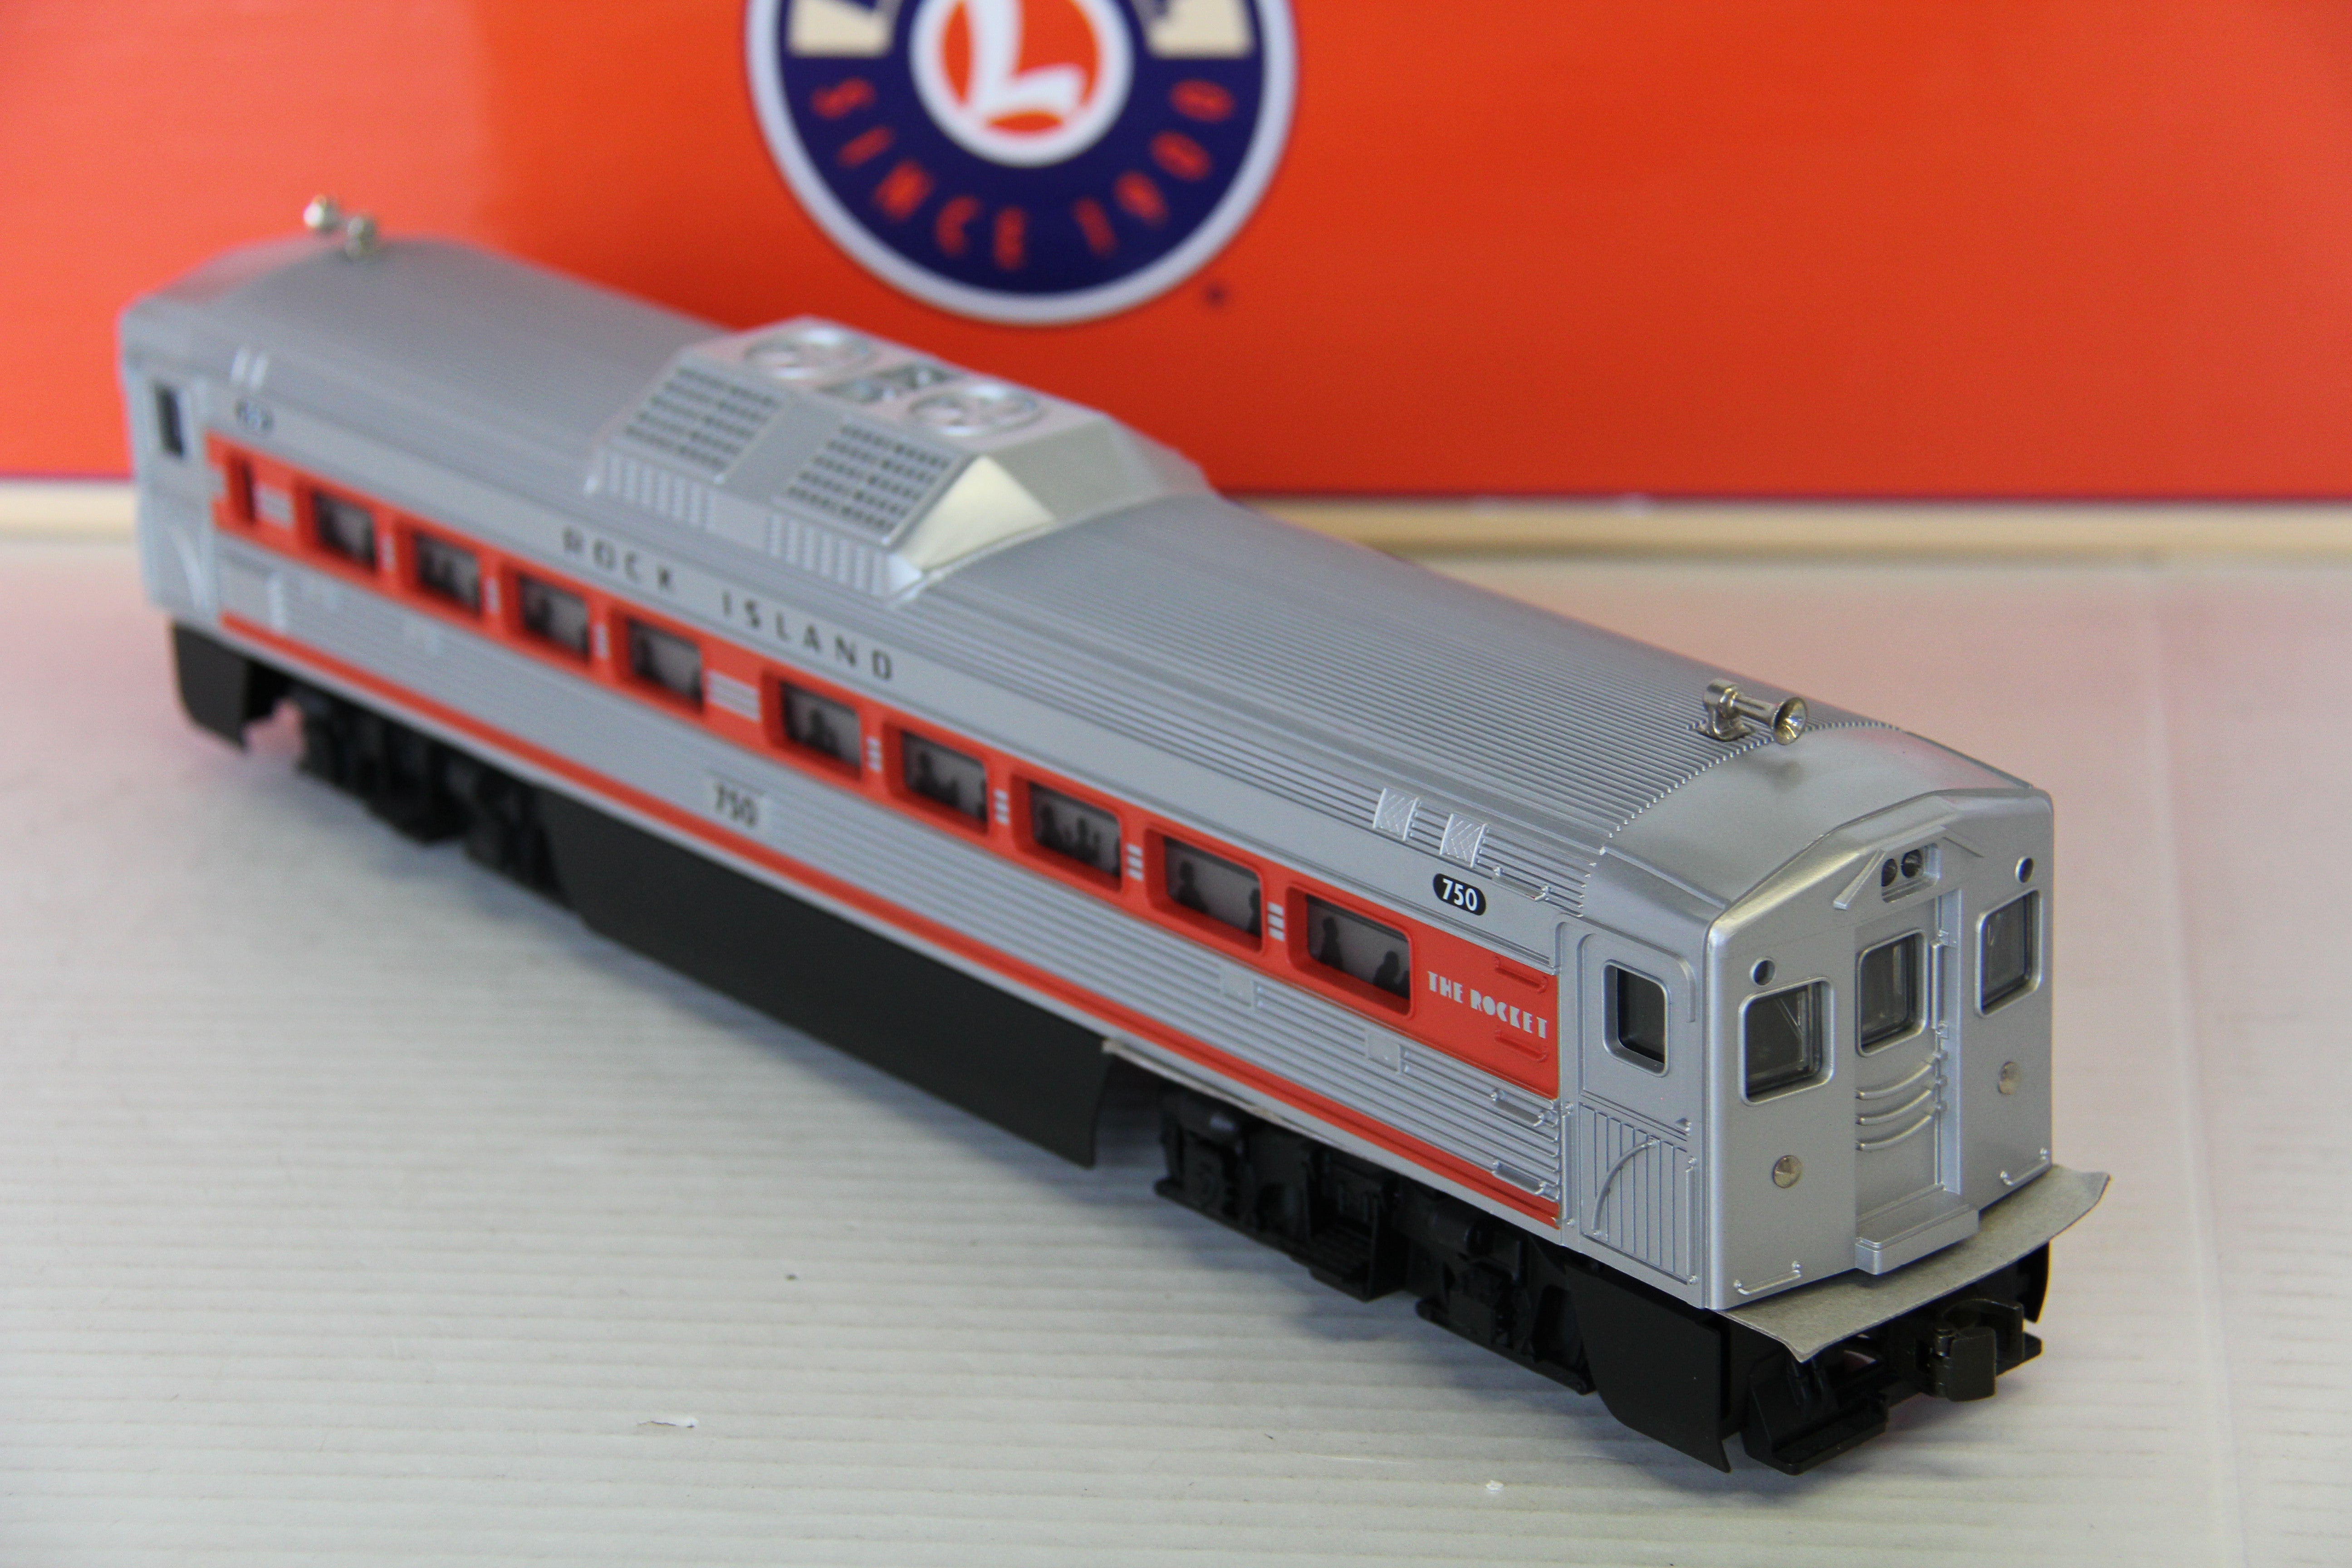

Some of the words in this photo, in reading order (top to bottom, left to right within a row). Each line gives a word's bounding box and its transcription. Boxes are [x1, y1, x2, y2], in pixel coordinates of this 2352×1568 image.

[563, 526, 672, 593] ROCK
[722, 590, 893, 681] ISLAND
[713, 783, 758, 828] 750
[1442, 877, 1478, 911] 750
[1427, 970, 1464, 1004] THE
[1470, 988, 1548, 1039] ROCKET
